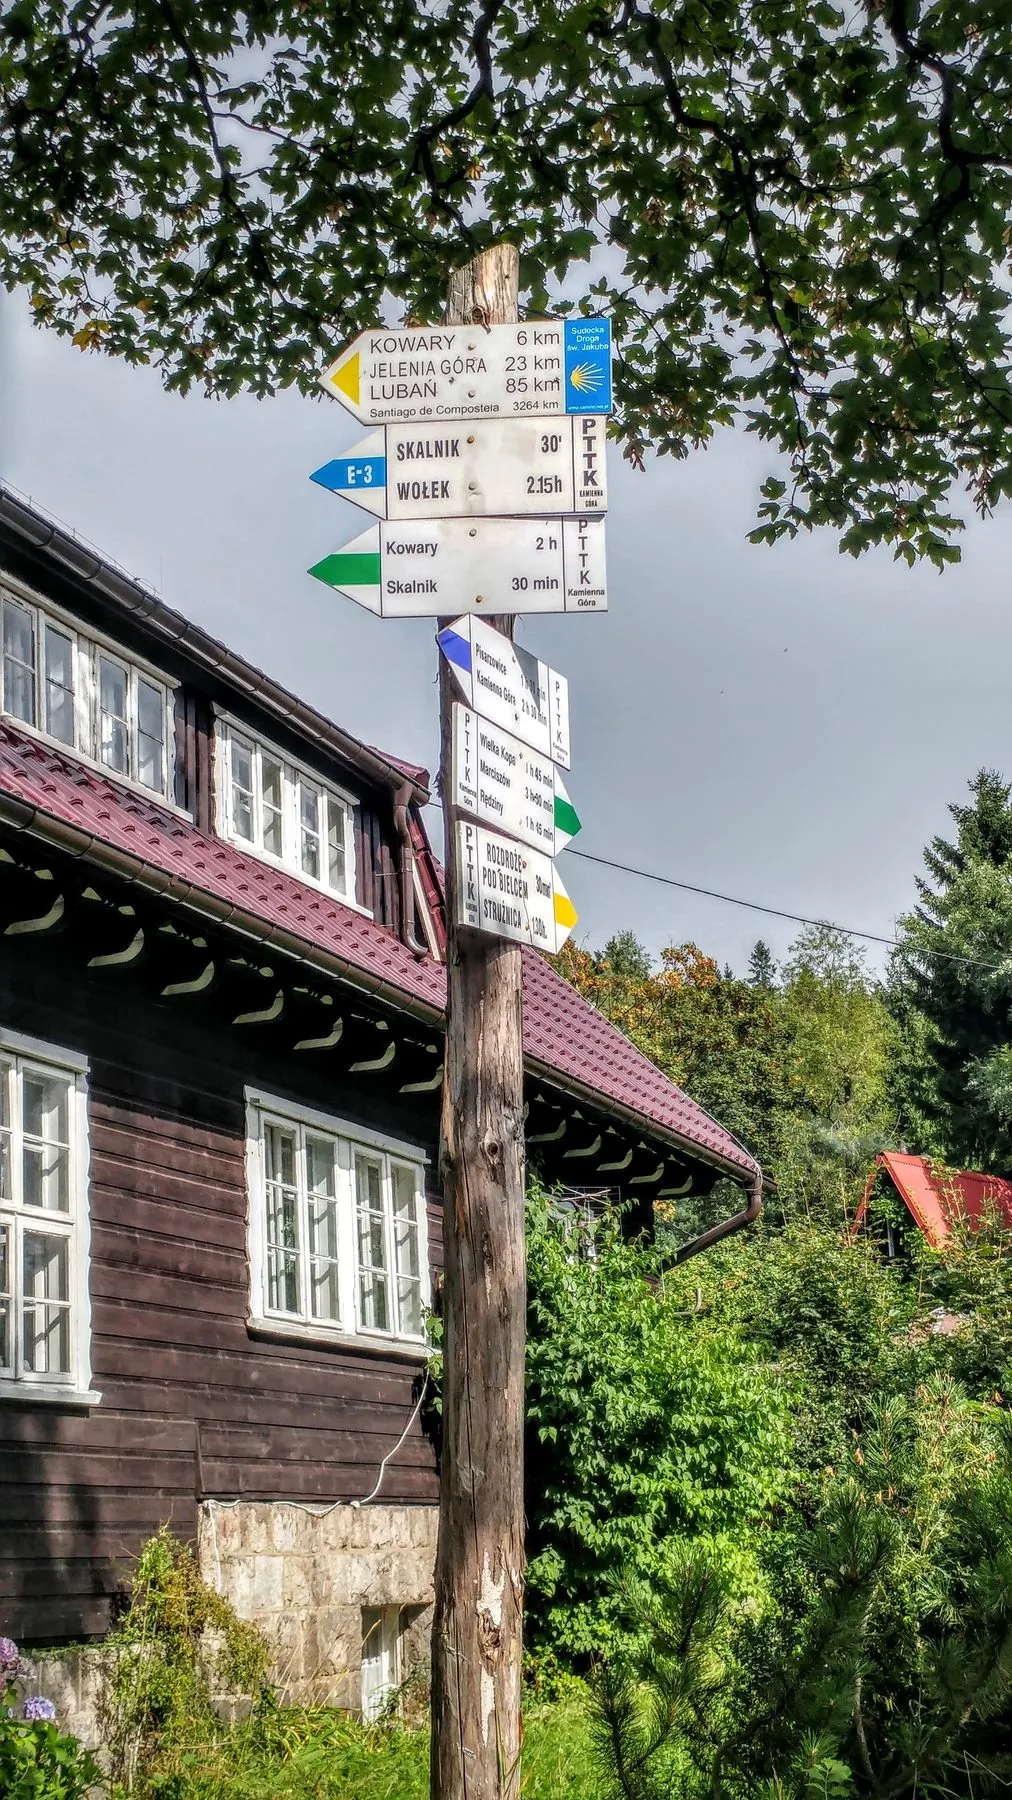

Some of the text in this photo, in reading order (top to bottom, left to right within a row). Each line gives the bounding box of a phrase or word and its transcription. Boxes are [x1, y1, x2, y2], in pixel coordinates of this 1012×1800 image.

[370, 329, 560, 354] KOWARY 6 km
[576, 335, 600, 344] Droga
[581, 343, 609, 351] Jakuba
[369, 355, 560, 379] JELENIA GÓRA 23 km
[370, 376, 560, 400] LUBAŃ 85 km
[369, 400, 559, 419] Santiago de Compostela 3264 km
[396, 435, 563, 462] SKALNIK 30'
[582, 418, 599, 487] PTTK
[347, 464, 373, 484] E-3
[396, 480, 450, 501] WOŁEK
[579, 489, 604, 498] KAMIENNA
[585, 499, 598, 508] GÓRA
[386, 536, 557, 557] Kowary 2 h
[577, 519, 591, 585] PTTK
[386, 576, 559, 594] Skalnik 30 min
[567, 588, 605, 597] Kamienna
[577, 597, 596, 607] Góra
[475, 643, 507, 676] Pisarzowice
[476, 669, 503, 698] Kamienna
[503, 685, 516, 706] Góra
[479, 732, 500, 758] Wielka
[501, 746, 516, 767] Kopa
[529, 763, 534, 777] h
[543, 774, 553, 790] min
[480, 759, 511, 788] Marciszów
[543, 799, 553, 814] min
[480, 789, 504, 816] Rędziny
[543, 827, 553, 842] min
[465, 825, 475, 901] PTTK
[486, 842, 522, 873] ROZDROŻE
[482, 866, 528, 900] POD BIELCEM
[483, 897, 522, 930] STRUŻNICA
